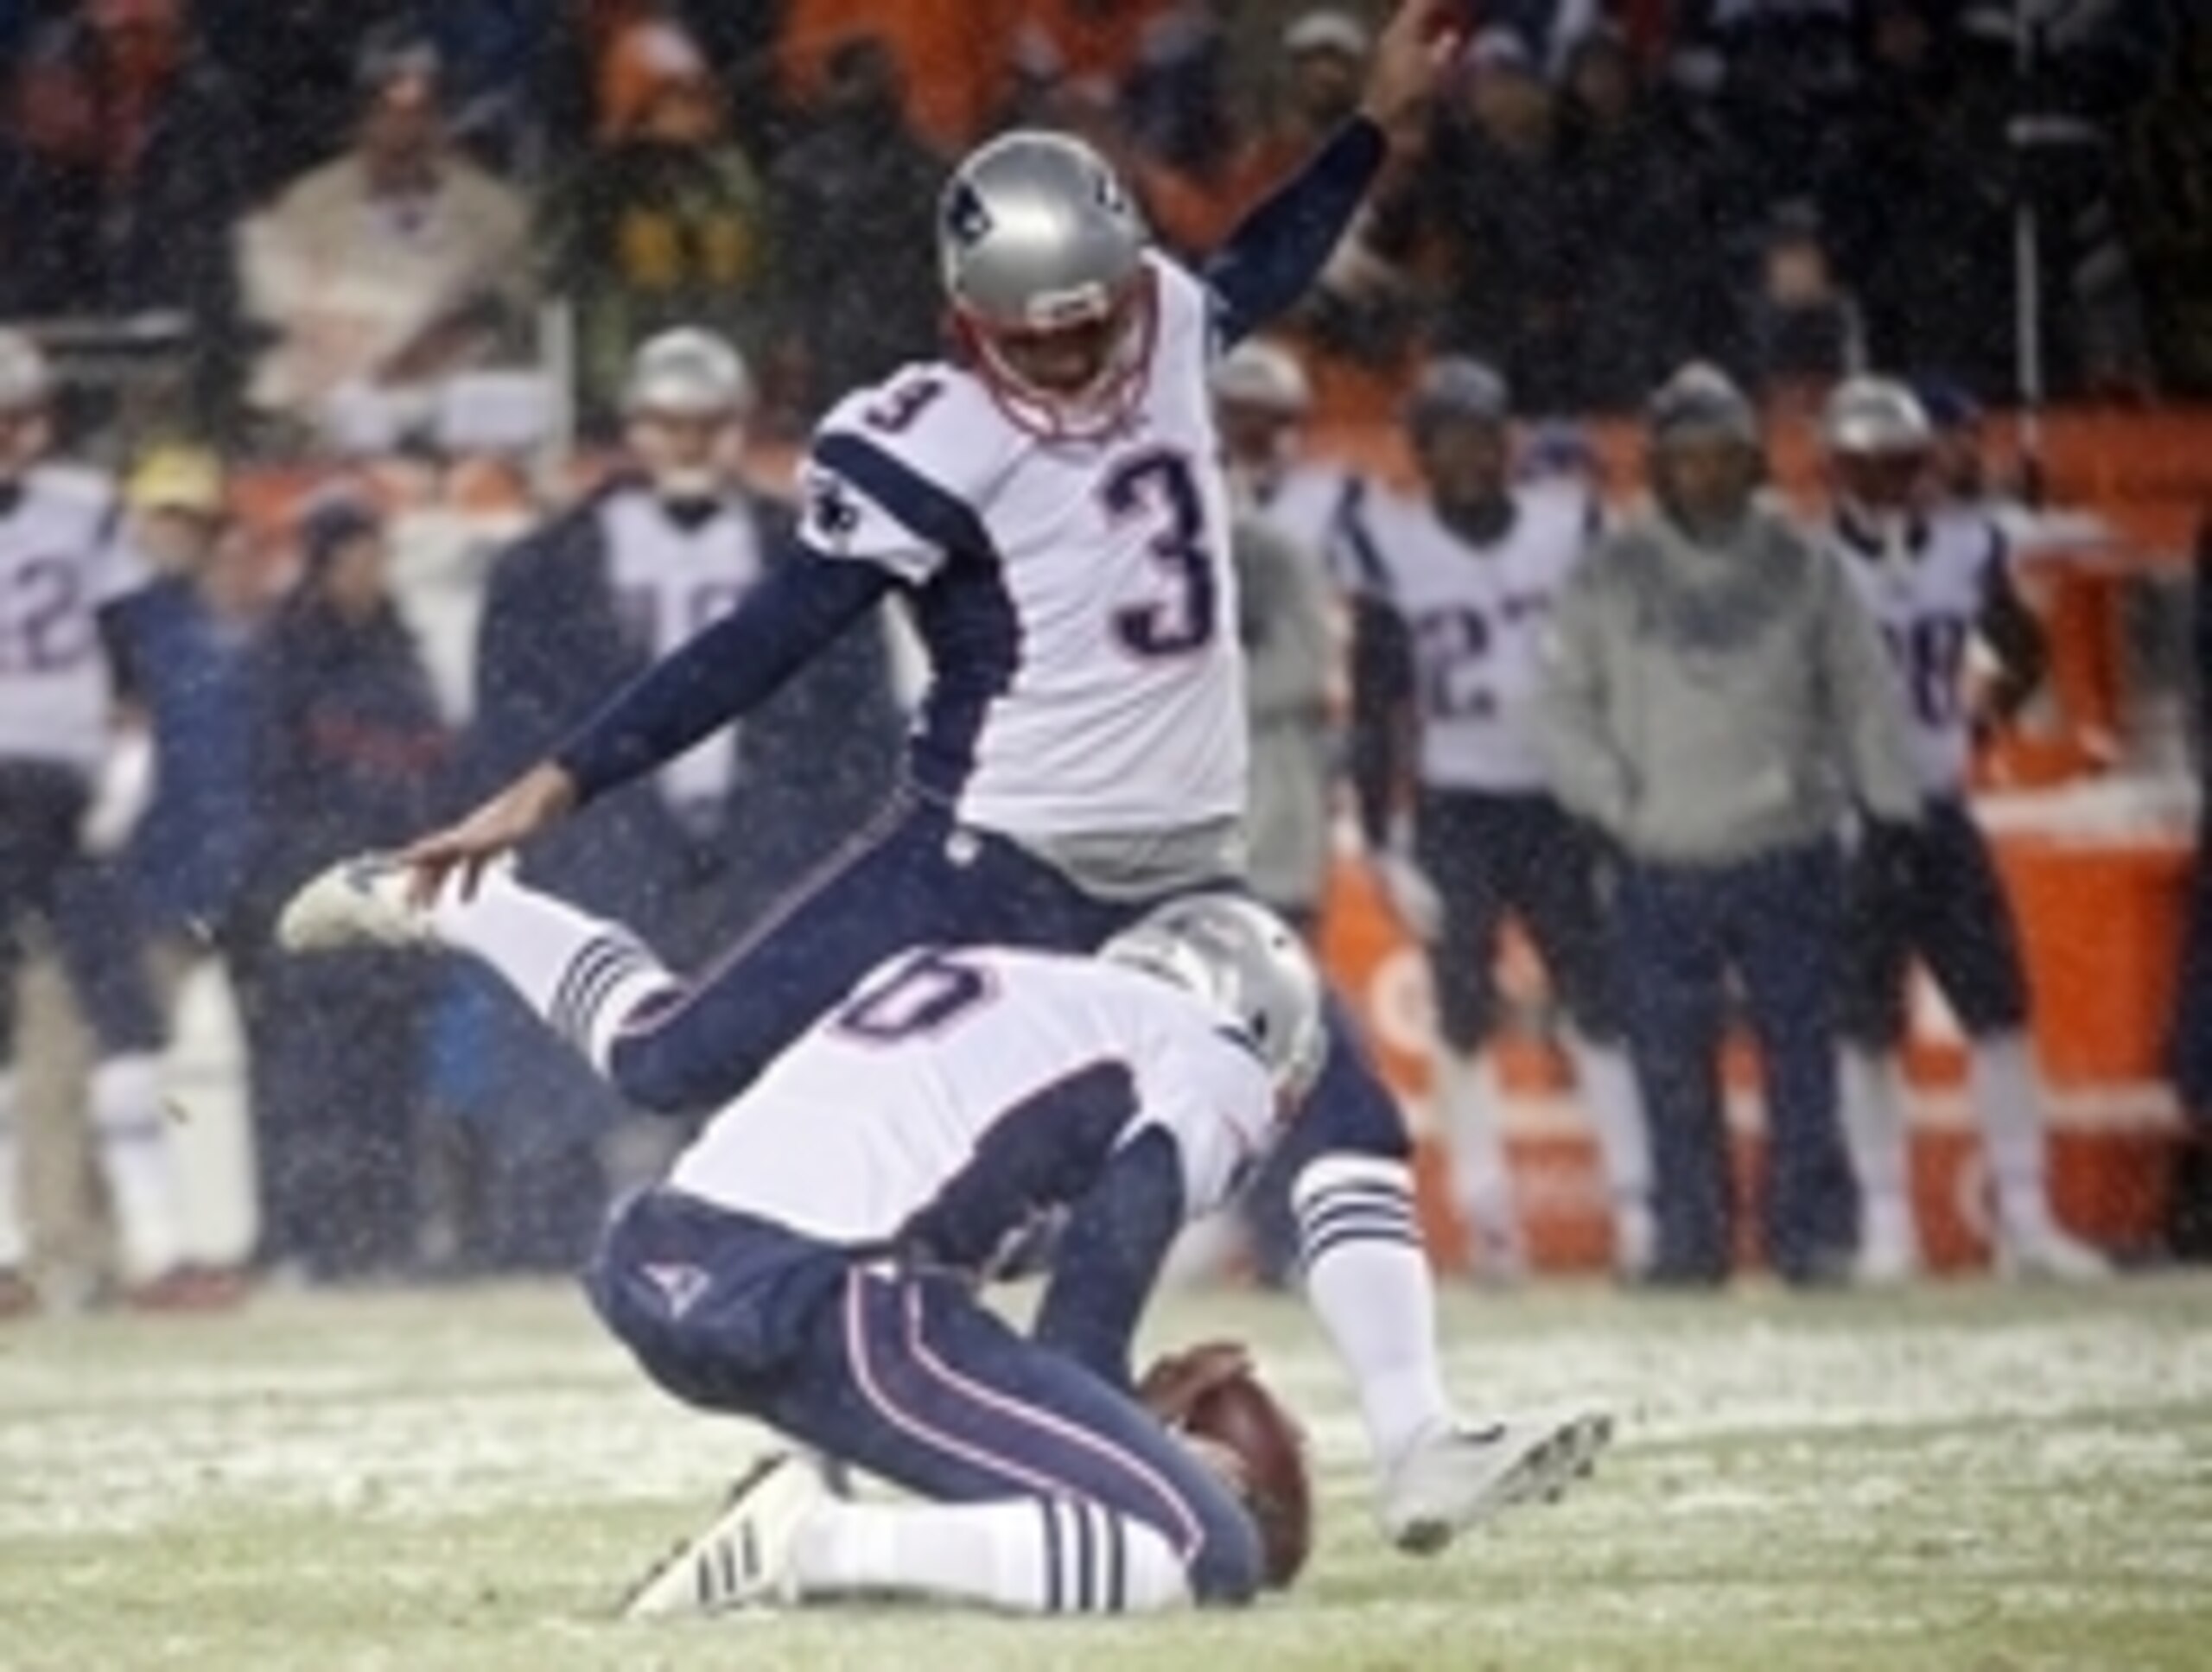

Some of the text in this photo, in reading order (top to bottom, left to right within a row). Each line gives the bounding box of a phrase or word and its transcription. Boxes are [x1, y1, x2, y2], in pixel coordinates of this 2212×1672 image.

[864, 378, 944, 435] 3
[1096, 447, 1217, 658] 3
[0, 558, 86, 674] 2
